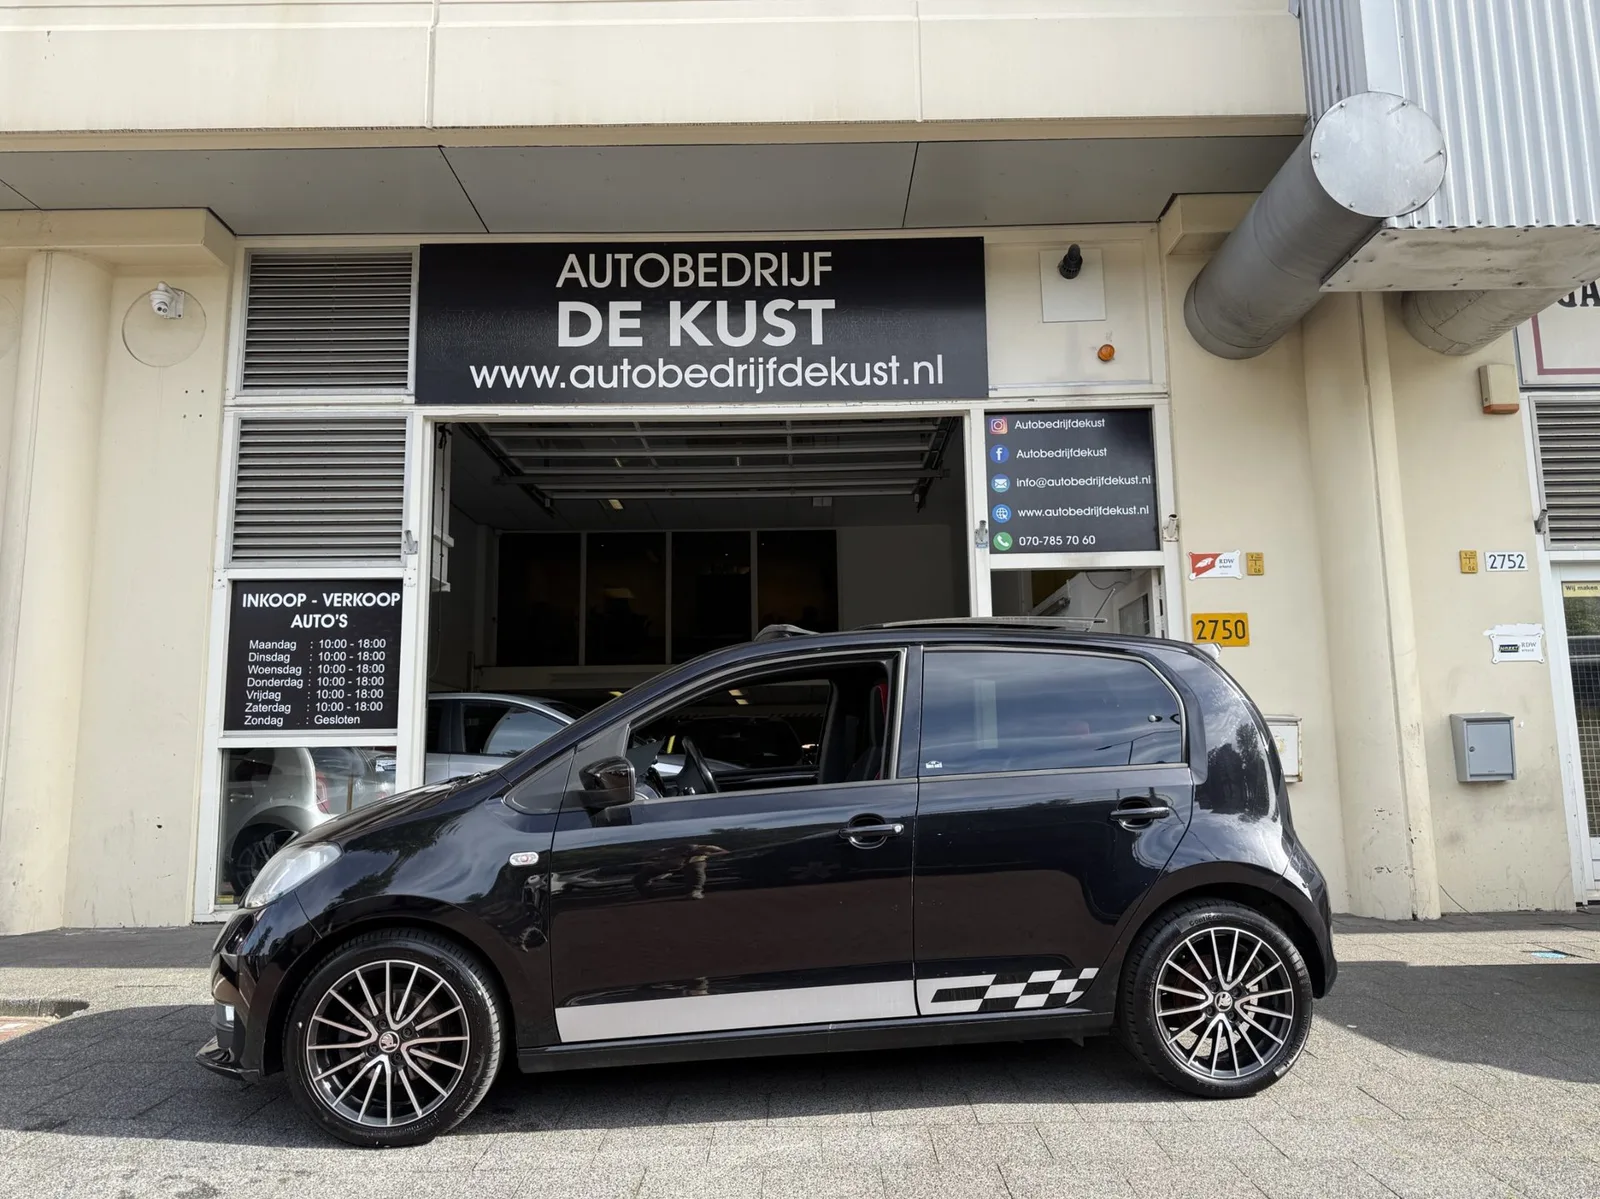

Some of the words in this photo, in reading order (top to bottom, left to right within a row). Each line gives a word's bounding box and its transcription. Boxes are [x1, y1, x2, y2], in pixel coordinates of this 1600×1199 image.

[556, 252, 832, 288] AUTOBEDRIJF
[558, 301, 643, 347] DE
[670, 299, 835, 347] KUST
[470, 355, 943, 393] www.autobedrijfdekust.nl
[1015, 419, 1105, 429] Autobedrijfdekust
[1017, 448, 1107, 459] Autobedrijfdekust
[1017, 475, 1150, 488] info@autobedrijfdekust.nl
[1018, 505, 1149, 517] www.autobedrijfdekust.nl
[1019, 536, 1062, 545] 070-785
[1066, 536, 1079, 545] 70
[1082, 535, 1095, 544] 60
[1489, 554, 1526, 569] 2752
[243, 593, 306, 607] INKOOP
[323, 593, 400, 606] VERKOOP
[291, 614, 347, 628] AUTO'S
[1196, 620, 1245, 639] 2750
[250, 640, 296, 651] Maandag
[320, 639, 347, 648] 10:00
[358, 639, 386, 648] 18:00
[249, 652, 290, 663] Dinsdag
[319, 652, 346, 661] 10:00
[357, 651, 385, 660] 18:00
[248, 665, 301, 676] Woensdag
[318, 664, 345, 673] 10:00
[357, 664, 384, 673] 18:00
[247, 678, 303, 689] Donderdag
[318, 677, 345, 686] 10:00
[356, 677, 384, 686] 18:00
[246, 690, 281, 701] Vrijdag
[317, 689, 344, 699] 10:00
[356, 689, 383, 698] 18:00
[245, 703, 291, 714] Zaterdag
[316, 702, 343, 711] 10:00
[355, 702, 383, 711] 18:00
[244, 716, 283, 727] Zondag
[314, 715, 360, 724] Gesloten
